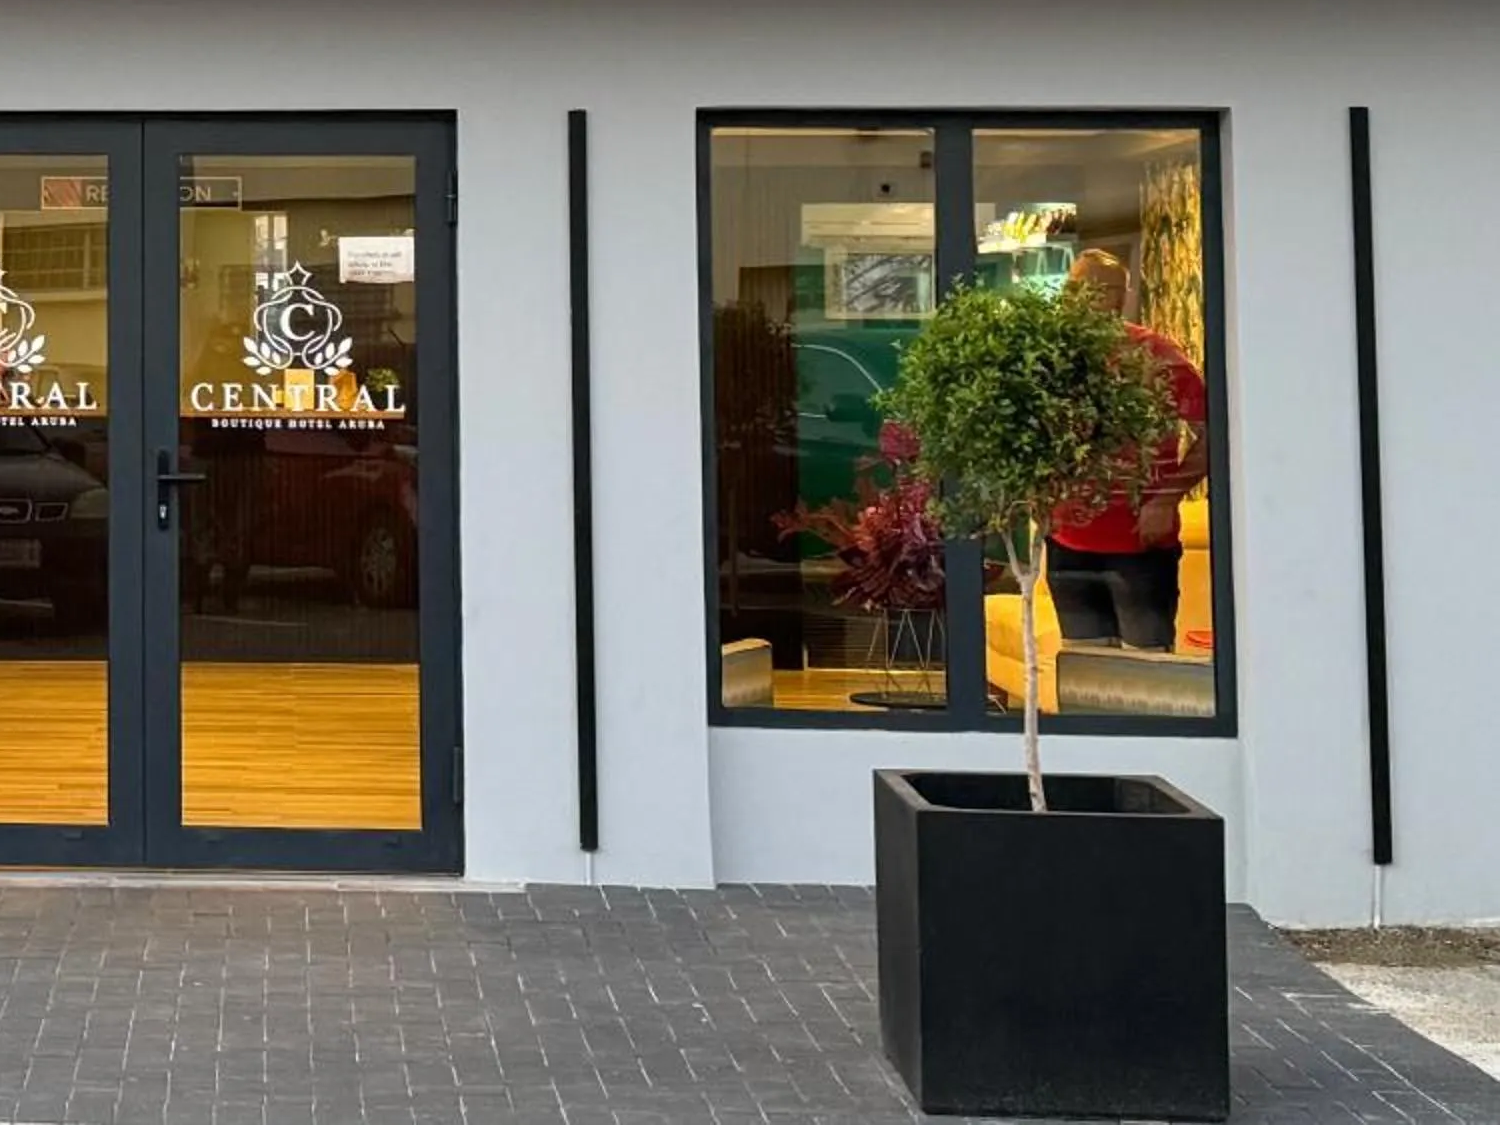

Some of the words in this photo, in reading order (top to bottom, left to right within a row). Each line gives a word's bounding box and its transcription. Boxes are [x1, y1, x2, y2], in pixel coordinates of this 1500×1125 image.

[281, 304, 315, 341] C
[190, 383, 407, 412] CENTRAL
[31, 416, 77, 426] ARUBA
[211, 418, 283, 429] BOUTIQUE
[288, 419, 333, 429] HOTEL
[339, 419, 386, 430] ARUBA
